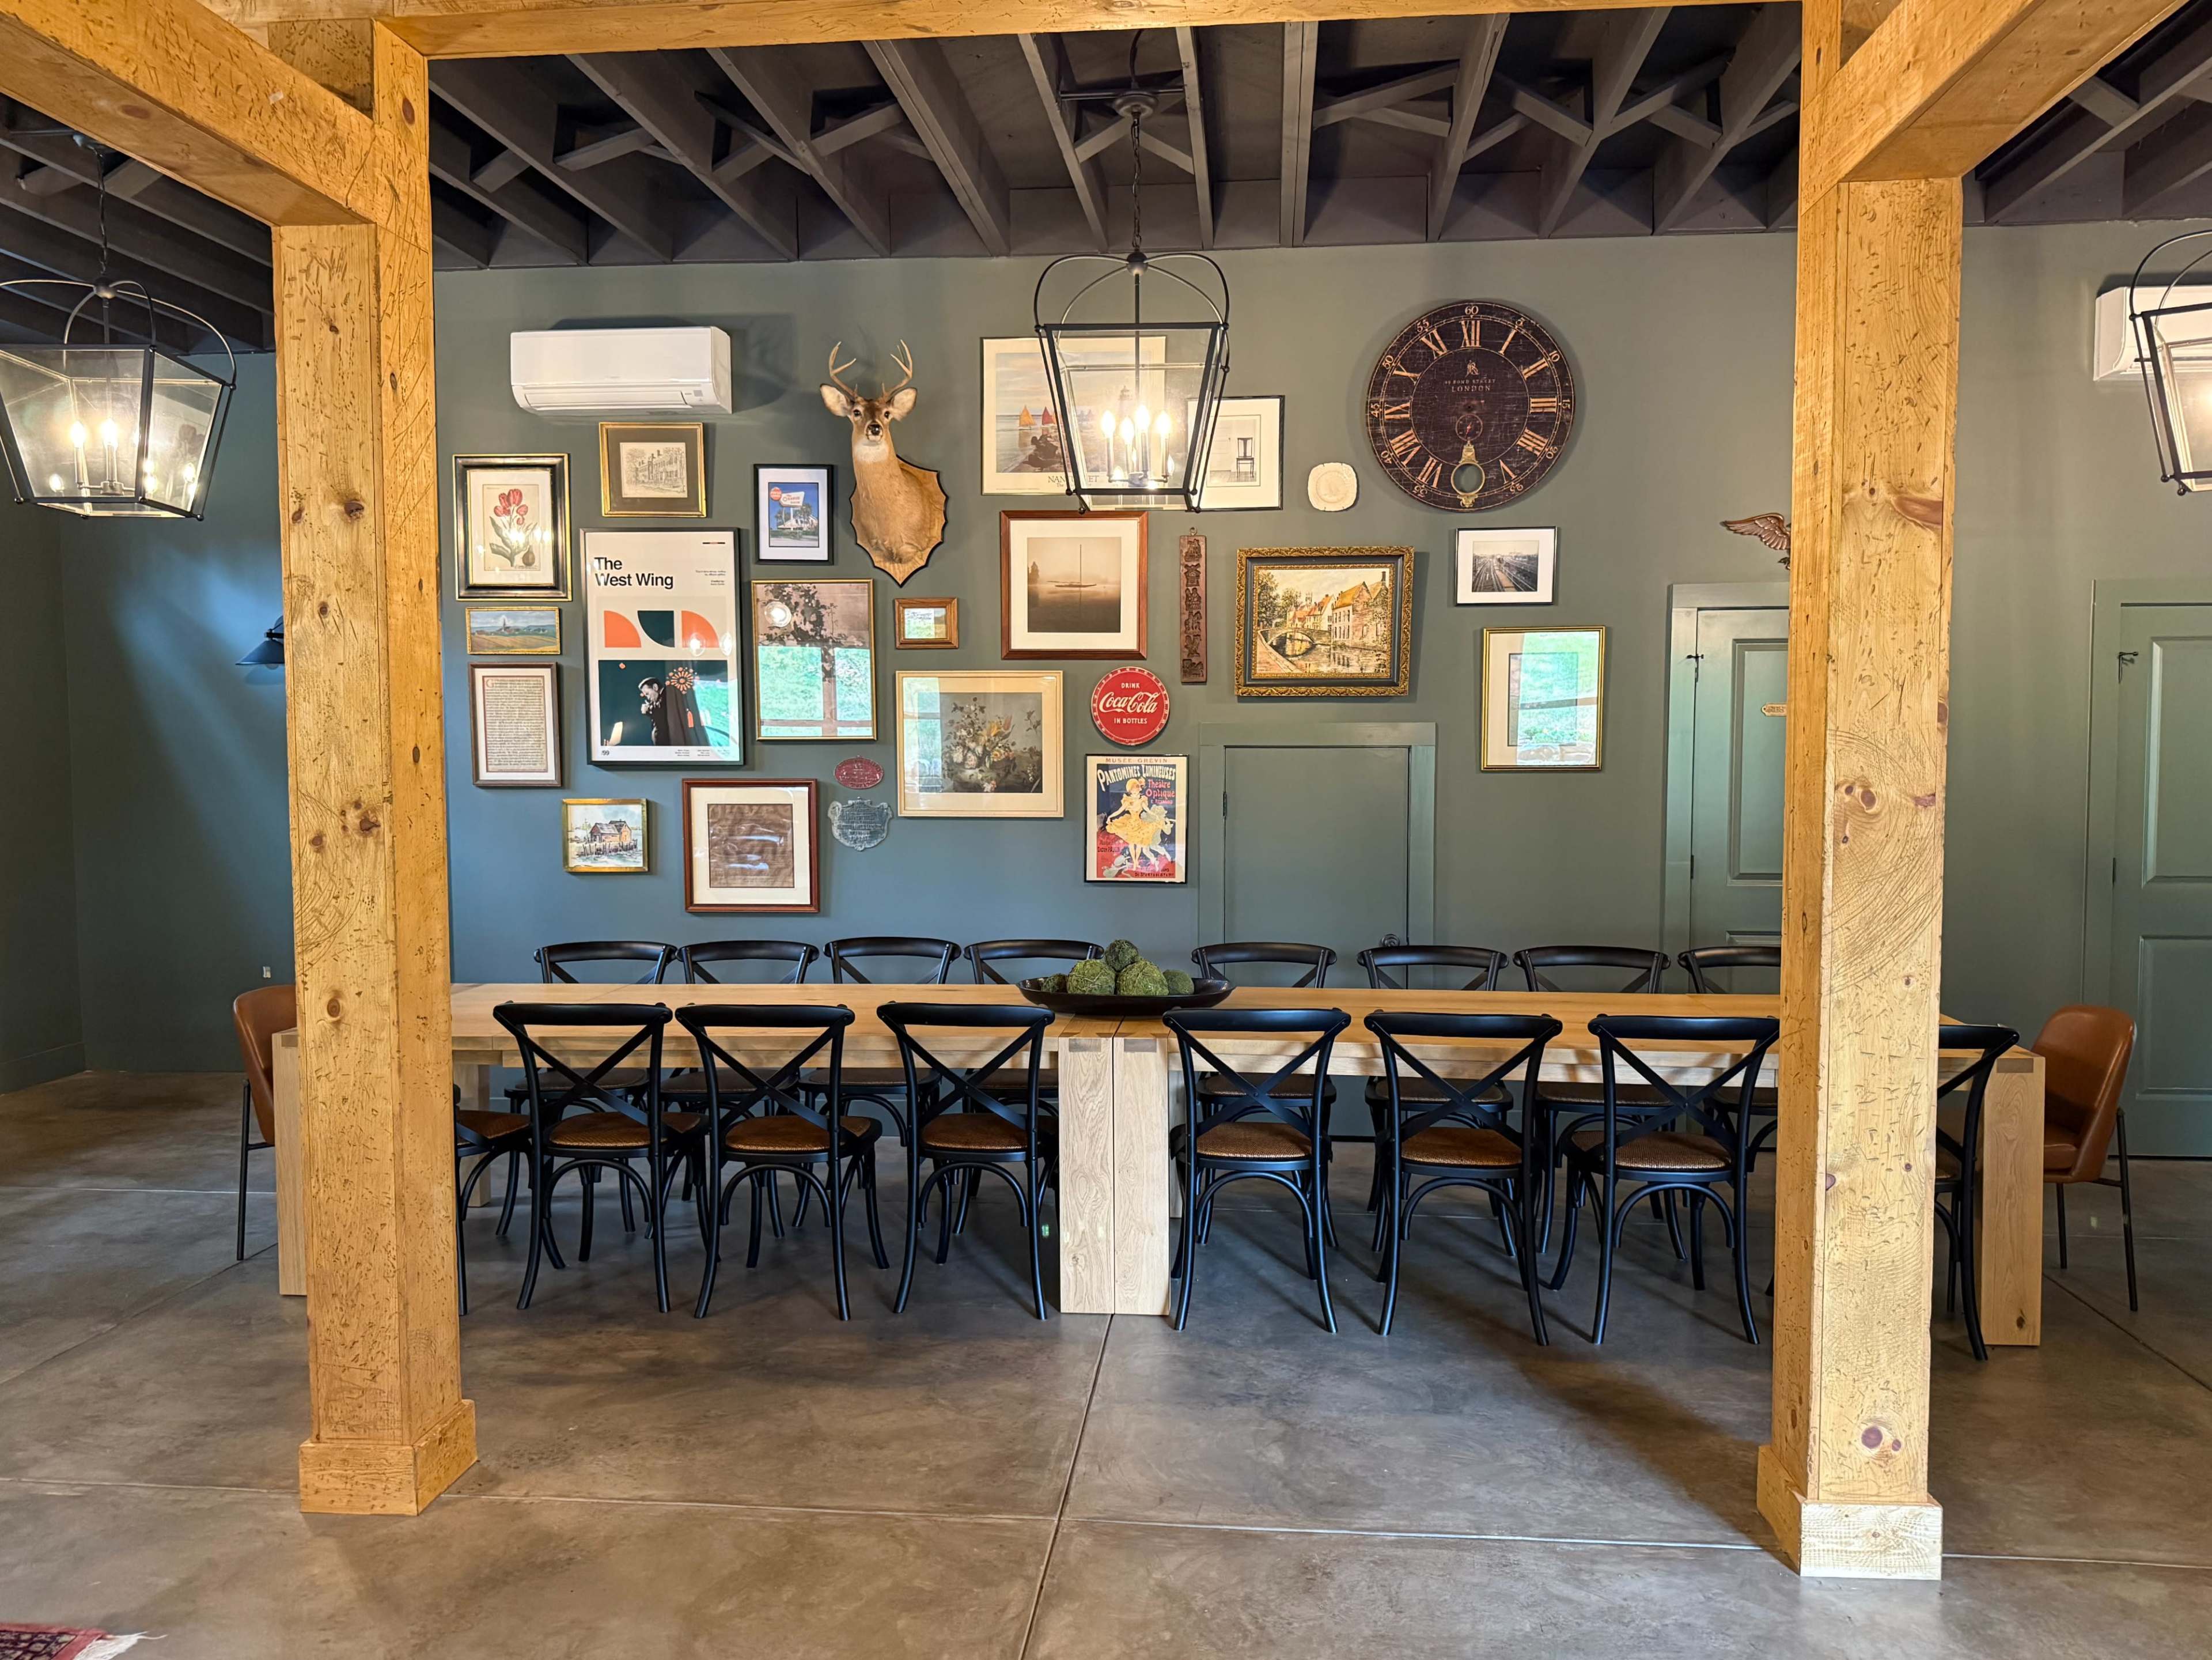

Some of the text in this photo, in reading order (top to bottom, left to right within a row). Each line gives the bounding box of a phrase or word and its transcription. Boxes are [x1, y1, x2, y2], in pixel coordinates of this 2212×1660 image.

[1465, 306, 1479, 315] 60
[1416, 319, 1429, 332] 55
[1459, 319, 1481, 347] XII
[1419, 326, 1448, 360] XI
[1382, 356, 1394, 369] 50
[1549, 350, 1560, 362] 10
[1392, 361, 1422, 385] X
[1522, 357, 1549, 381] II
[1370, 403, 1380, 418] 45
[1384, 400, 1411, 421] IX
[1529, 397, 1557, 414] III
[1562, 399, 1570, 409] 15
[1389, 427, 1422, 467] VIII
[1546, 447, 1558, 459] 20
[1381, 451, 1392, 464] 40
[1415, 455, 1443, 489] VII
[1499, 459, 1517, 484] V
[594, 557, 622, 570] The
[594, 573, 673, 589] West Wing
[1099, 691, 1161, 713] Coca-Cola
[1141, 764, 1176, 781] LUMINEUSES
[1146, 788, 1176, 799] Optique
